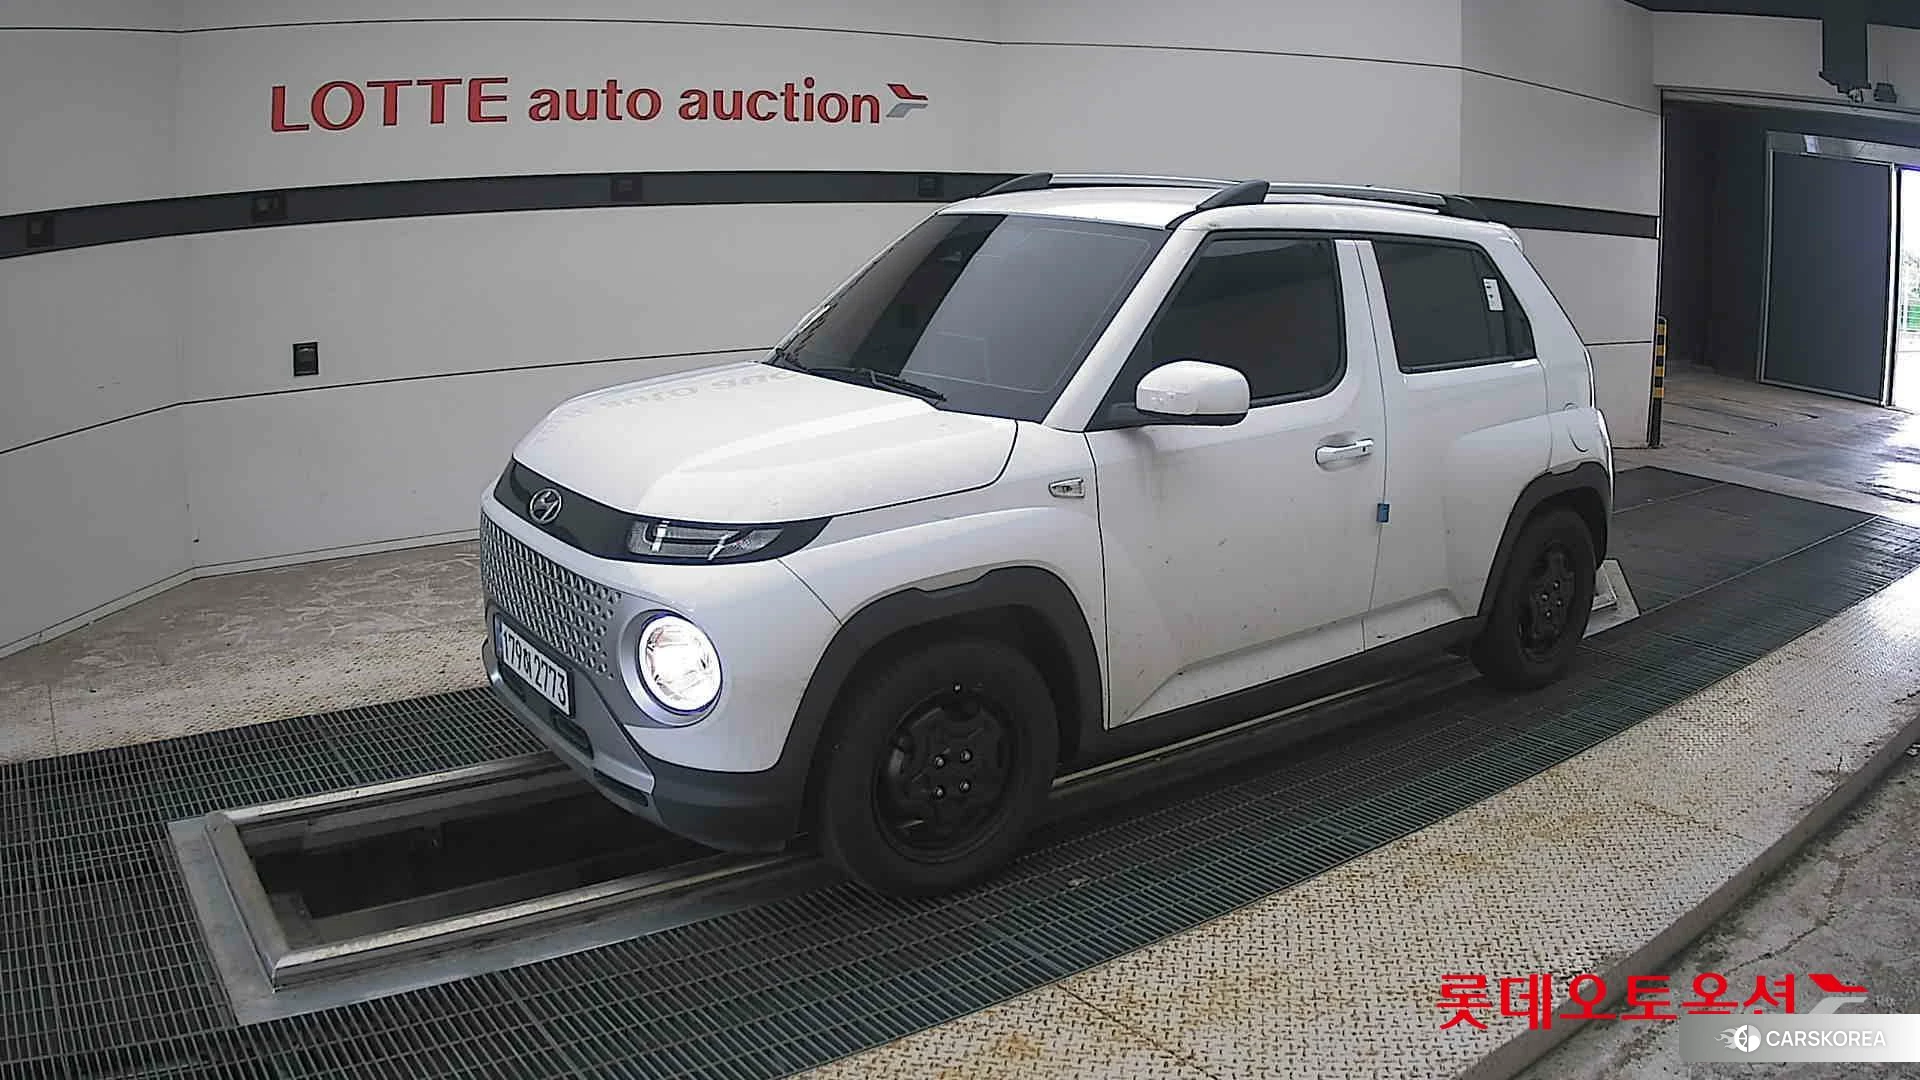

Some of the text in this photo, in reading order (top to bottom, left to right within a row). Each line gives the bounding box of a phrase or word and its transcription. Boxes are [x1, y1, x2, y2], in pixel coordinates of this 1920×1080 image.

[271, 77, 880, 132] LOTTE auto auction
